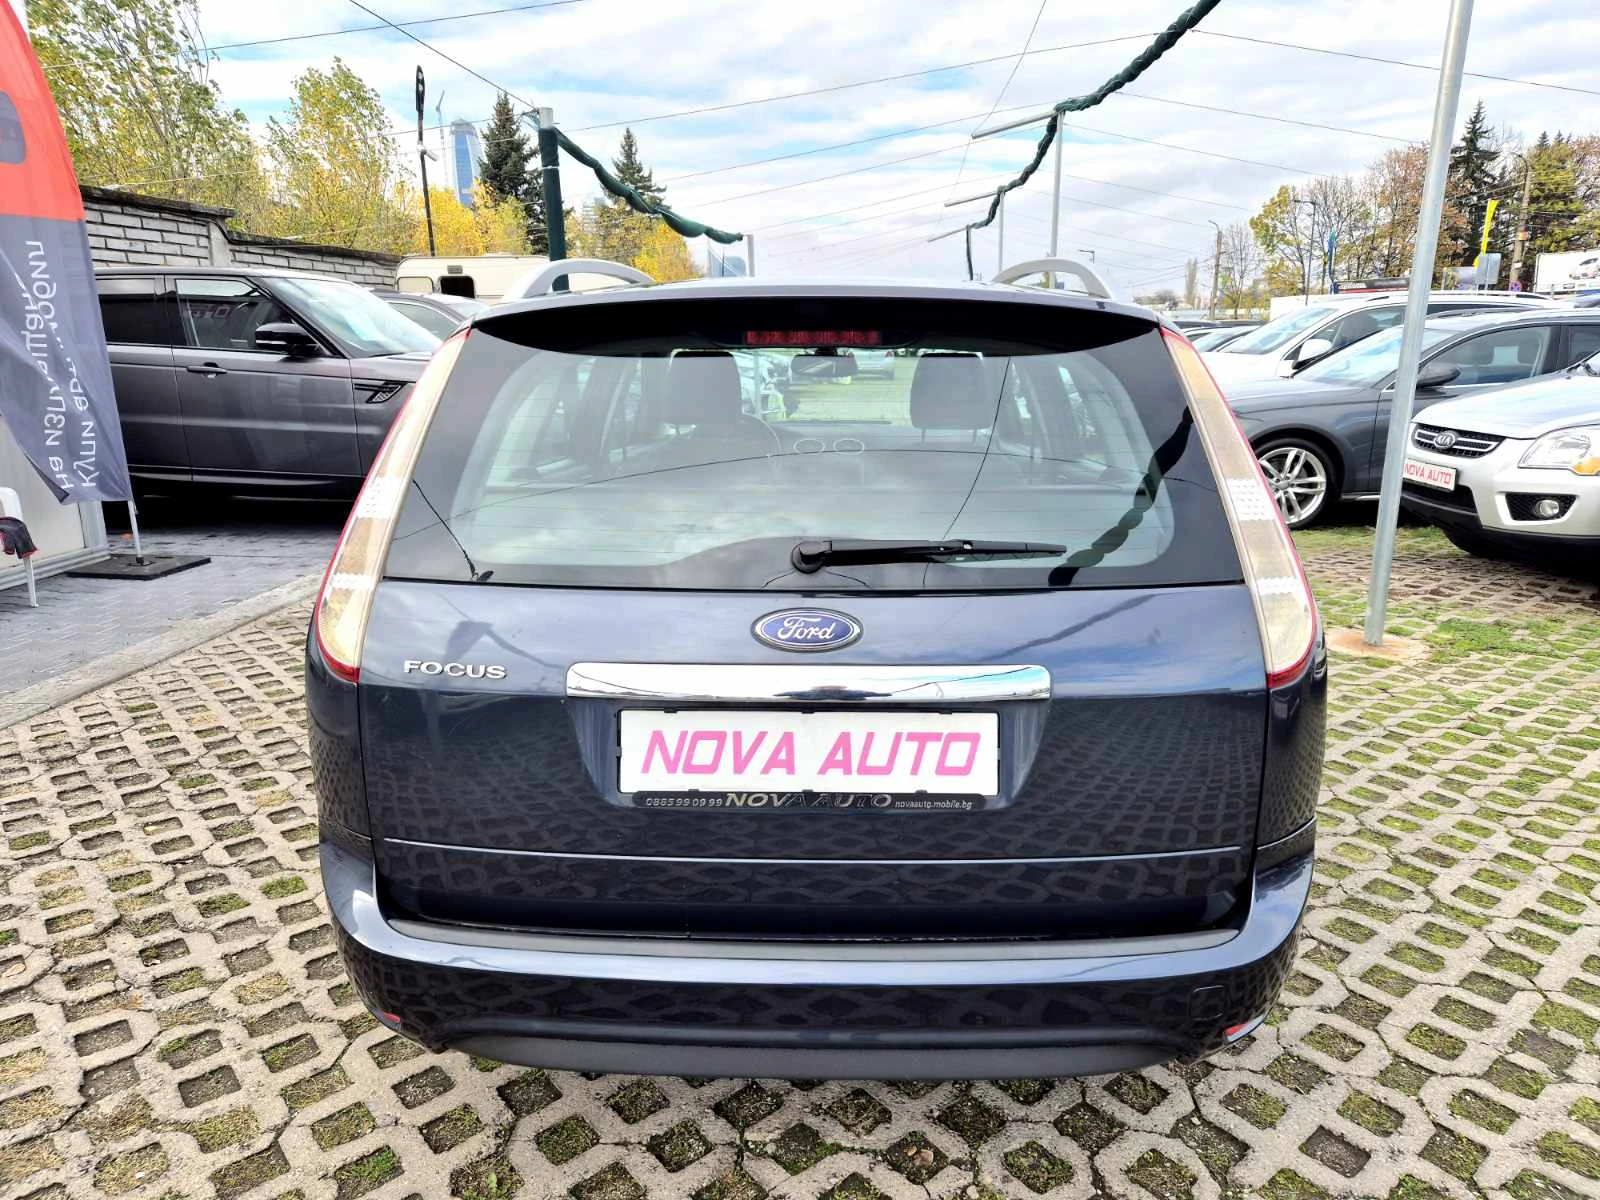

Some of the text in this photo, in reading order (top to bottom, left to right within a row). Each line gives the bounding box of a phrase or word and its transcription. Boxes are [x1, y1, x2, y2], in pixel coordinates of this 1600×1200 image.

[1404, 463, 1453, 485] NOVA AUTO
[777, 617, 836, 640] Ford
[403, 660, 508, 679] FOCUS
[641, 730, 981, 776] NOVA AUTO
[725, 793, 806, 807] NOVA
[812, 794, 892, 807] AUTO
